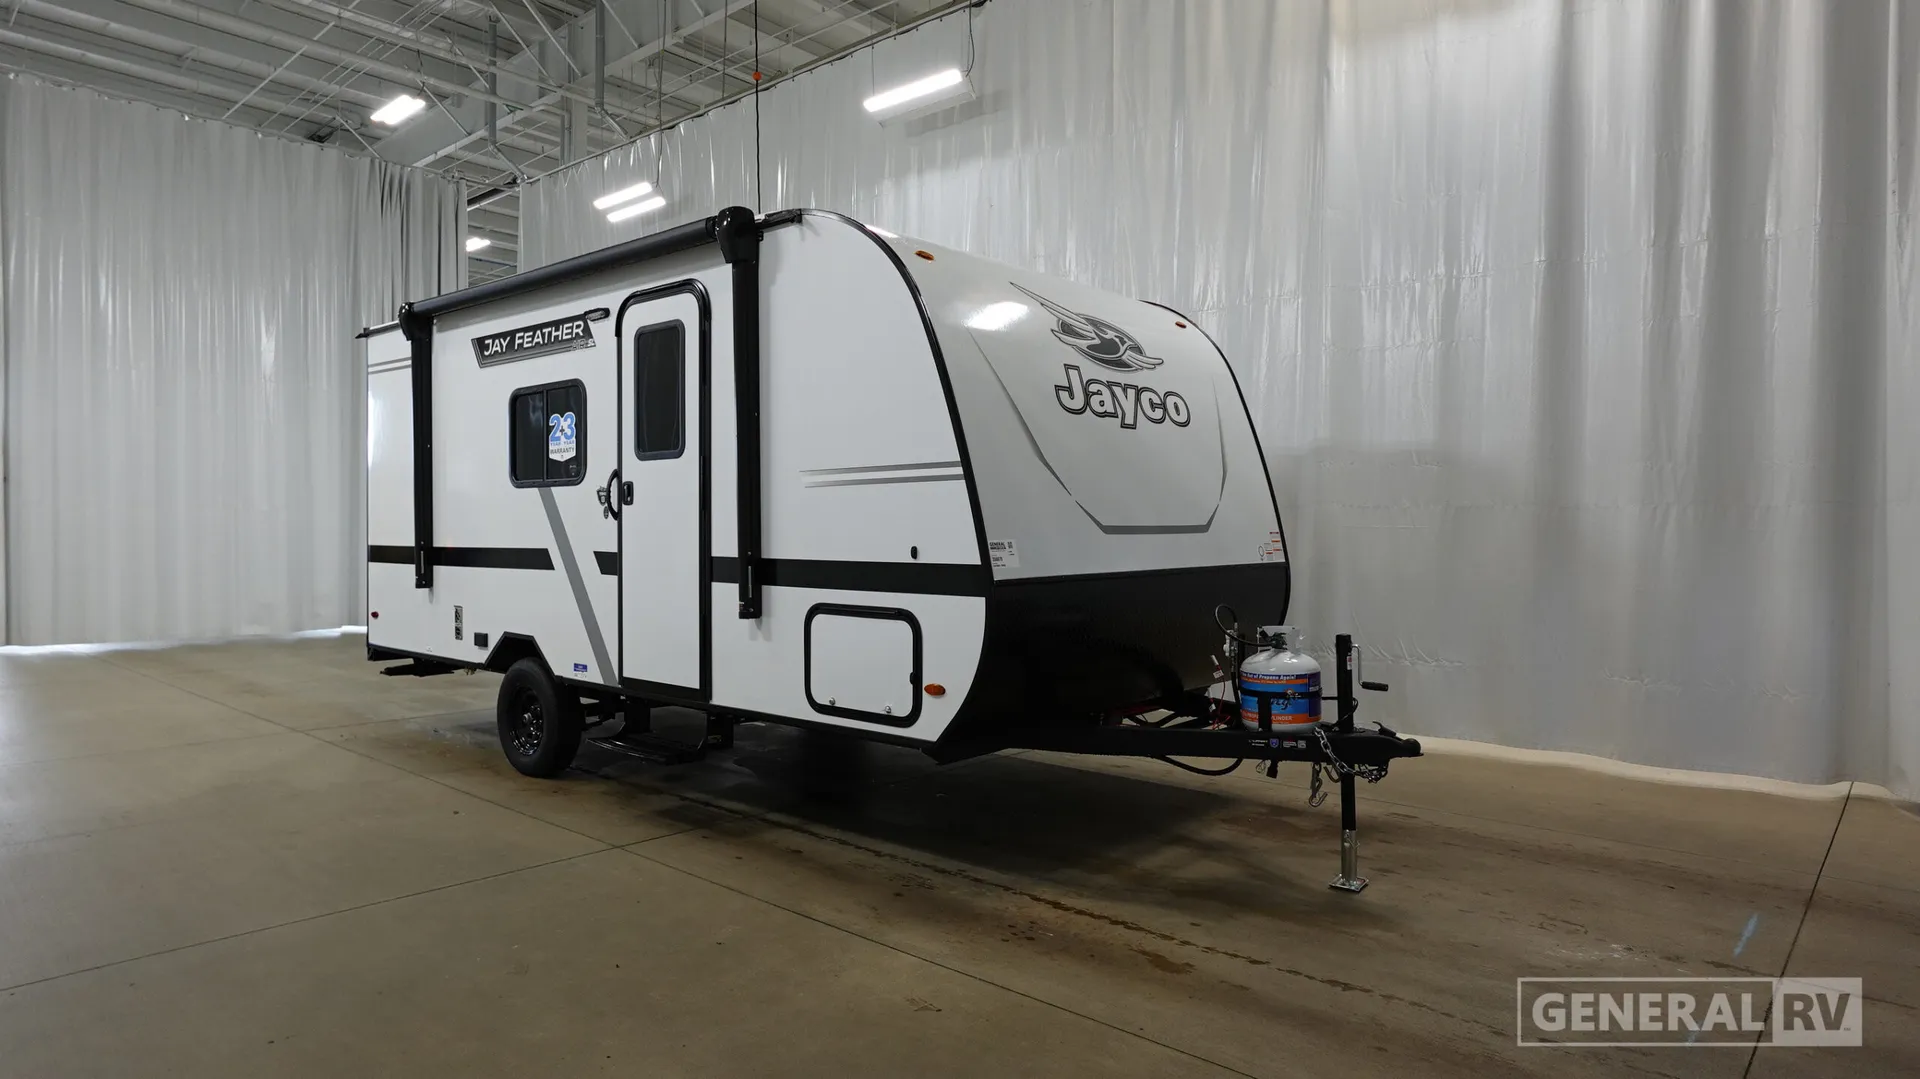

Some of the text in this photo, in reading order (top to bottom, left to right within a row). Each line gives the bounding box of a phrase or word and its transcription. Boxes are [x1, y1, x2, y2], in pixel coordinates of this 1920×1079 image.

[484, 321, 584, 356] JAY FEATHER
[1054, 363, 1191, 430] Jayco
[550, 447, 575, 455] WARRANTY
